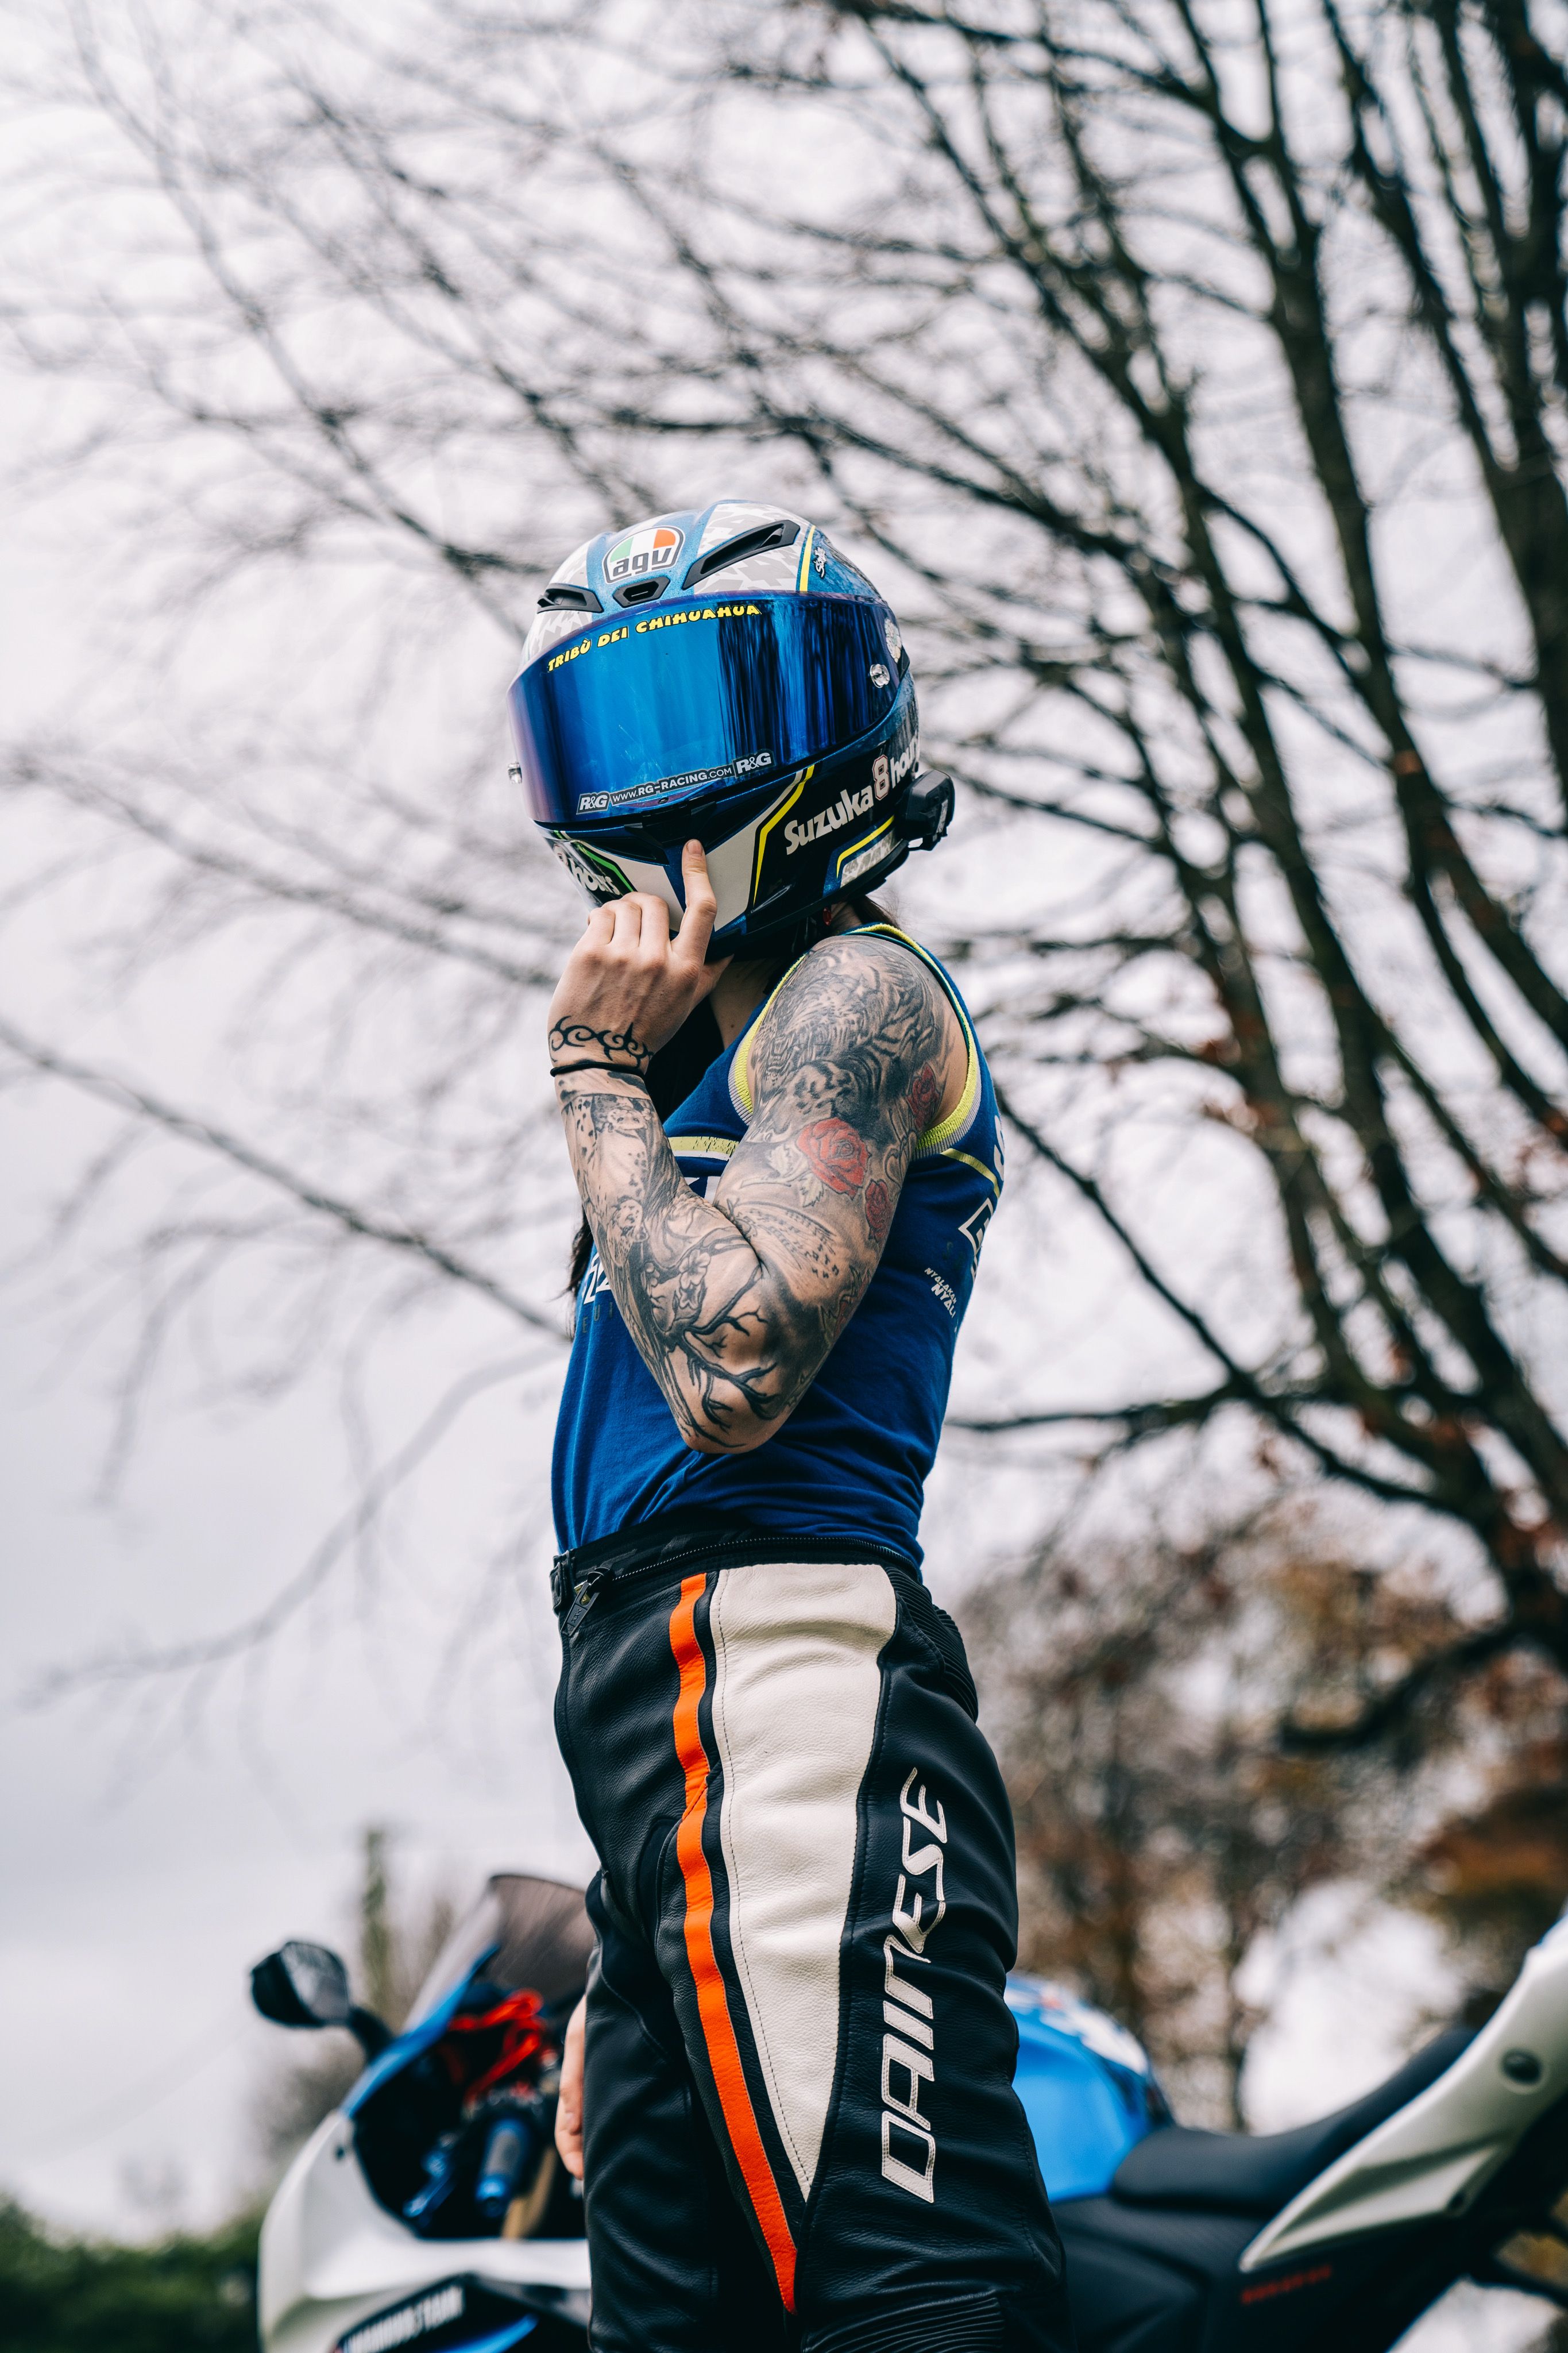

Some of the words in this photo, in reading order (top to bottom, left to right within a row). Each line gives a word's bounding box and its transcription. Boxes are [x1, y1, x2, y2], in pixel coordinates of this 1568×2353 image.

[613, 547, 672, 577] agv
[547, 638, 592, 672] TRIBÙ
[597, 627, 629, 647] DEI
[635, 605, 762, 633] CHIHUAHUA
[579, 794, 608, 811] R&G
[736, 753, 772, 774] R&G
[784, 785, 874, 855] Suzuka
[872, 754, 890, 800] 8
[924, 1267, 957, 1304] NYALAKAN
[931, 1283, 956, 1318] NYALI
[881, 1766, 948, 2205] DAINESE
